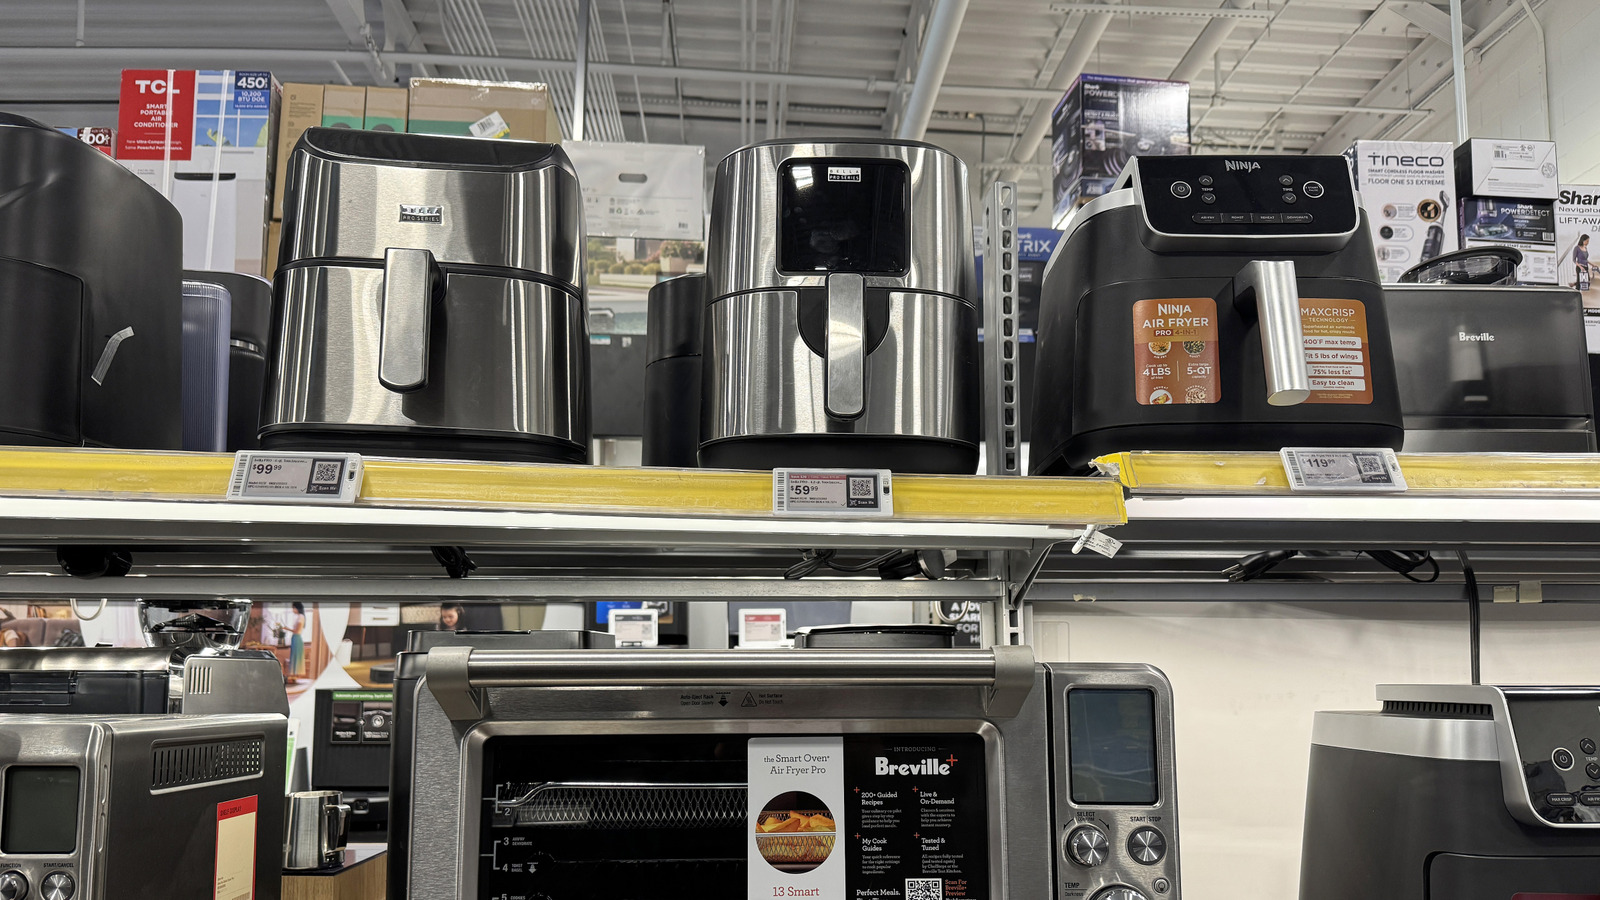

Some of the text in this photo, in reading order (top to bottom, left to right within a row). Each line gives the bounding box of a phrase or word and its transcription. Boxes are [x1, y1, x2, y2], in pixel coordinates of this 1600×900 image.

[237, 77, 265, 88] 450
[1225, 159, 1261, 173] NINJA
[1500, 208, 1550, 217] POWERDETECT
[1158, 303, 1192, 317] NINJA
[1301, 308, 1355, 317] MAXCRISP
[1142, 317, 1209, 329] AIR FRYER
[1459, 332, 1495, 341] Breville
[1143, 367, 1171, 376] 4 LBS
[1187, 366, 1212, 375] 5-QT
[956, 624, 978, 633] FOR
[775, 754, 802, 762] Smart
[770, 765, 826, 776] Air Fryer Pro
[504, 807, 510, 816] 2
[503, 836, 509, 846] 3
[502, 863, 508, 872] 4
[773, 886, 820, 897] 13 Smart
[880, 888, 901, 896] Meals.
